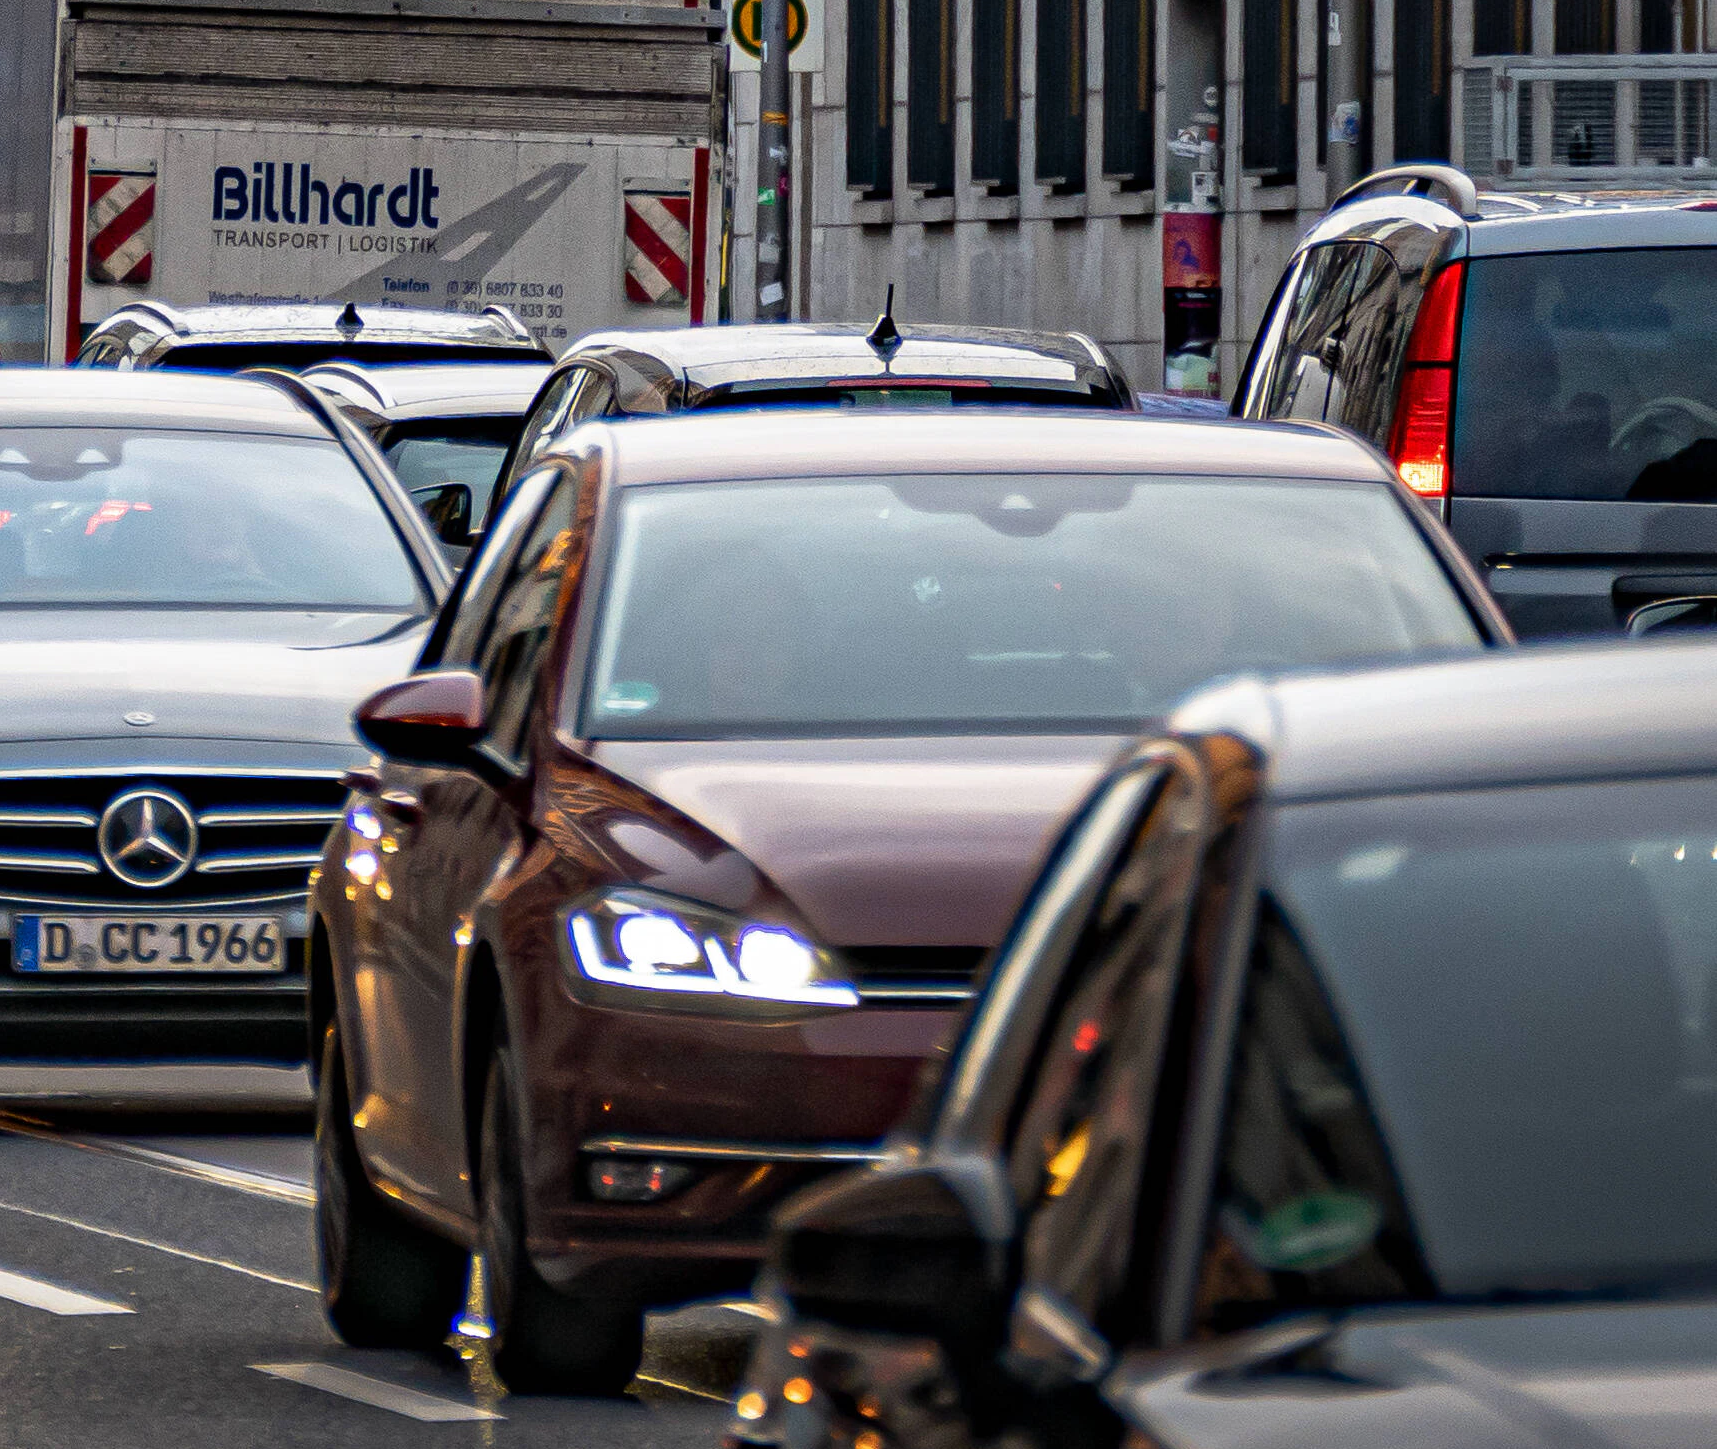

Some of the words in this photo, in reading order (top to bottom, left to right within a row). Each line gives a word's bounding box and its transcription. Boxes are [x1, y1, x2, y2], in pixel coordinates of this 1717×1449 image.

[212, 161, 439, 229] Billhardt
[213, 229, 330, 250] TRANSPORT
[350, 235, 439, 254] LOGISTIK
[382, 277, 430, 293] Telefon
[486, 282, 515, 296] 6807
[520, 283, 544, 298] 833
[547, 284, 564, 299] 40
[546, 305, 563, 319] 30
[44, 922, 72, 963] D
[101, 922, 160, 963] CC
[169, 922, 277, 963] 1966
